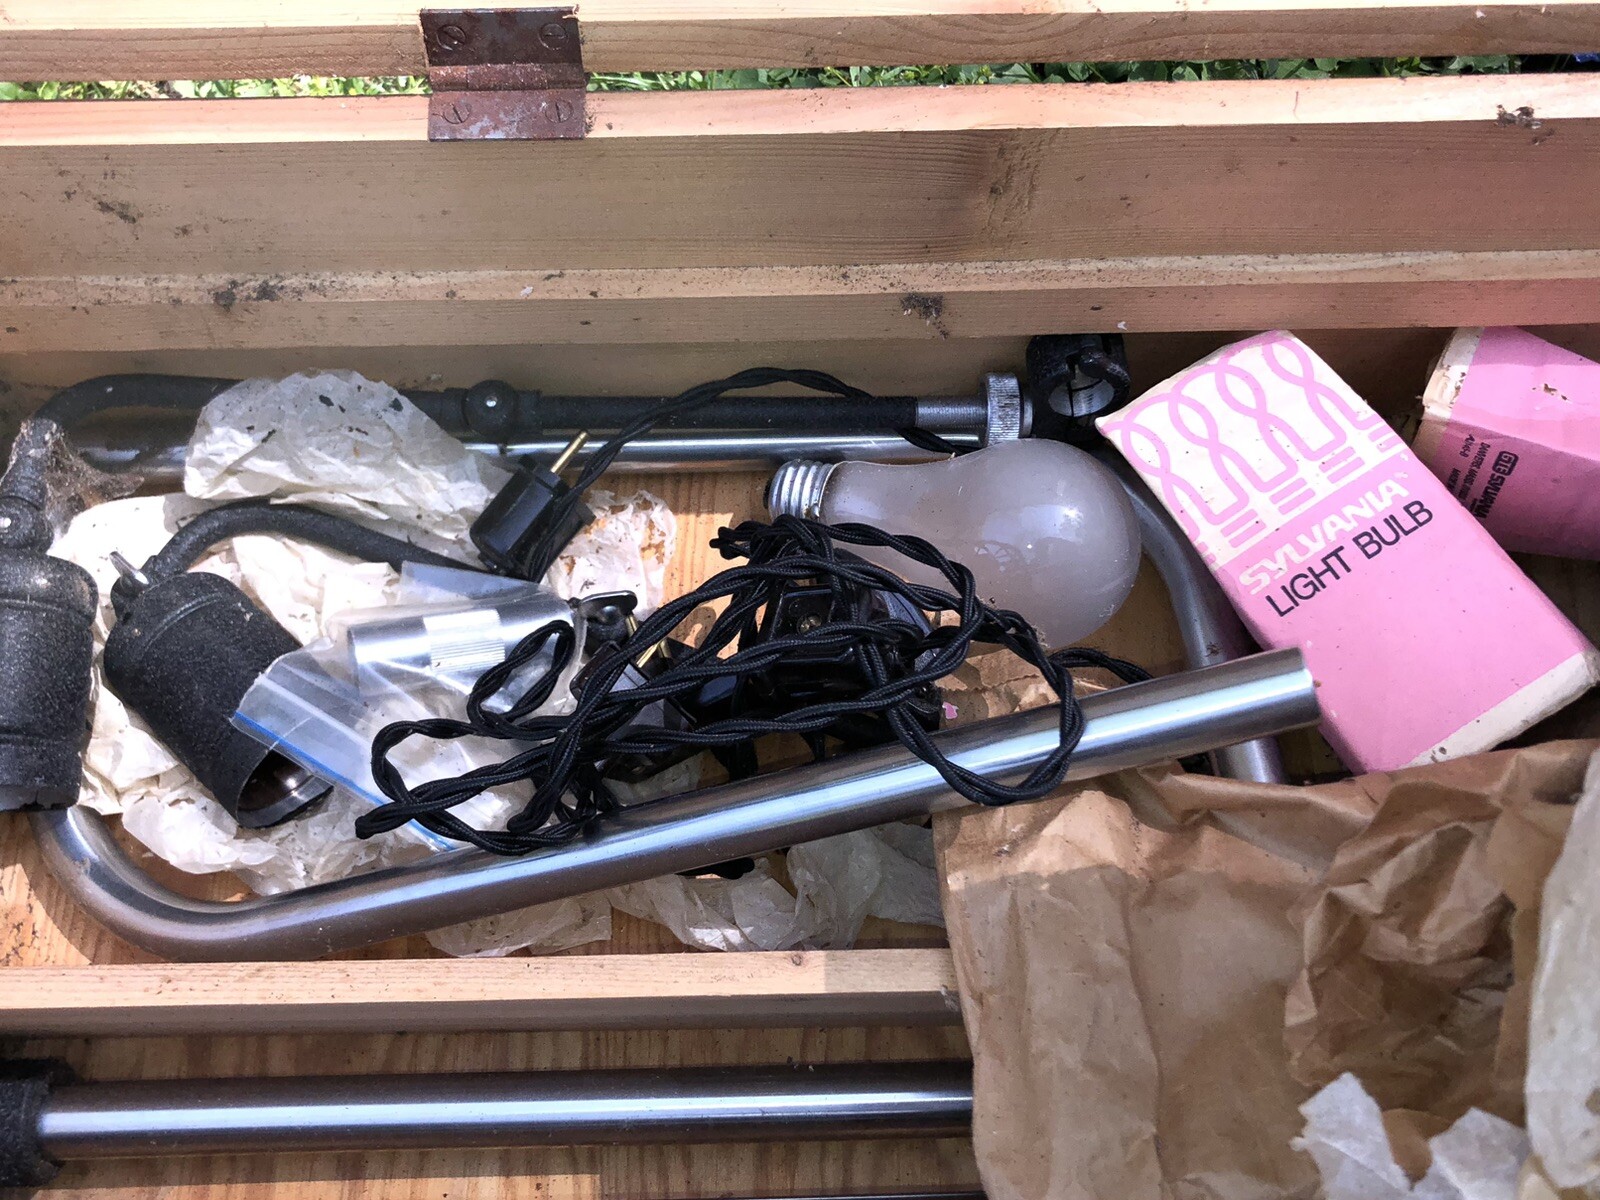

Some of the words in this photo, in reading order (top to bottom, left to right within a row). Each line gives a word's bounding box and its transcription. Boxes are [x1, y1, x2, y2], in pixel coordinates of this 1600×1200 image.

[1496, 452, 1517, 475] GTE
[1239, 479, 1409, 595] SYLVANIA
[1265, 545, 1351, 617] LIGHT
[1352, 500, 1433, 560] BULB
